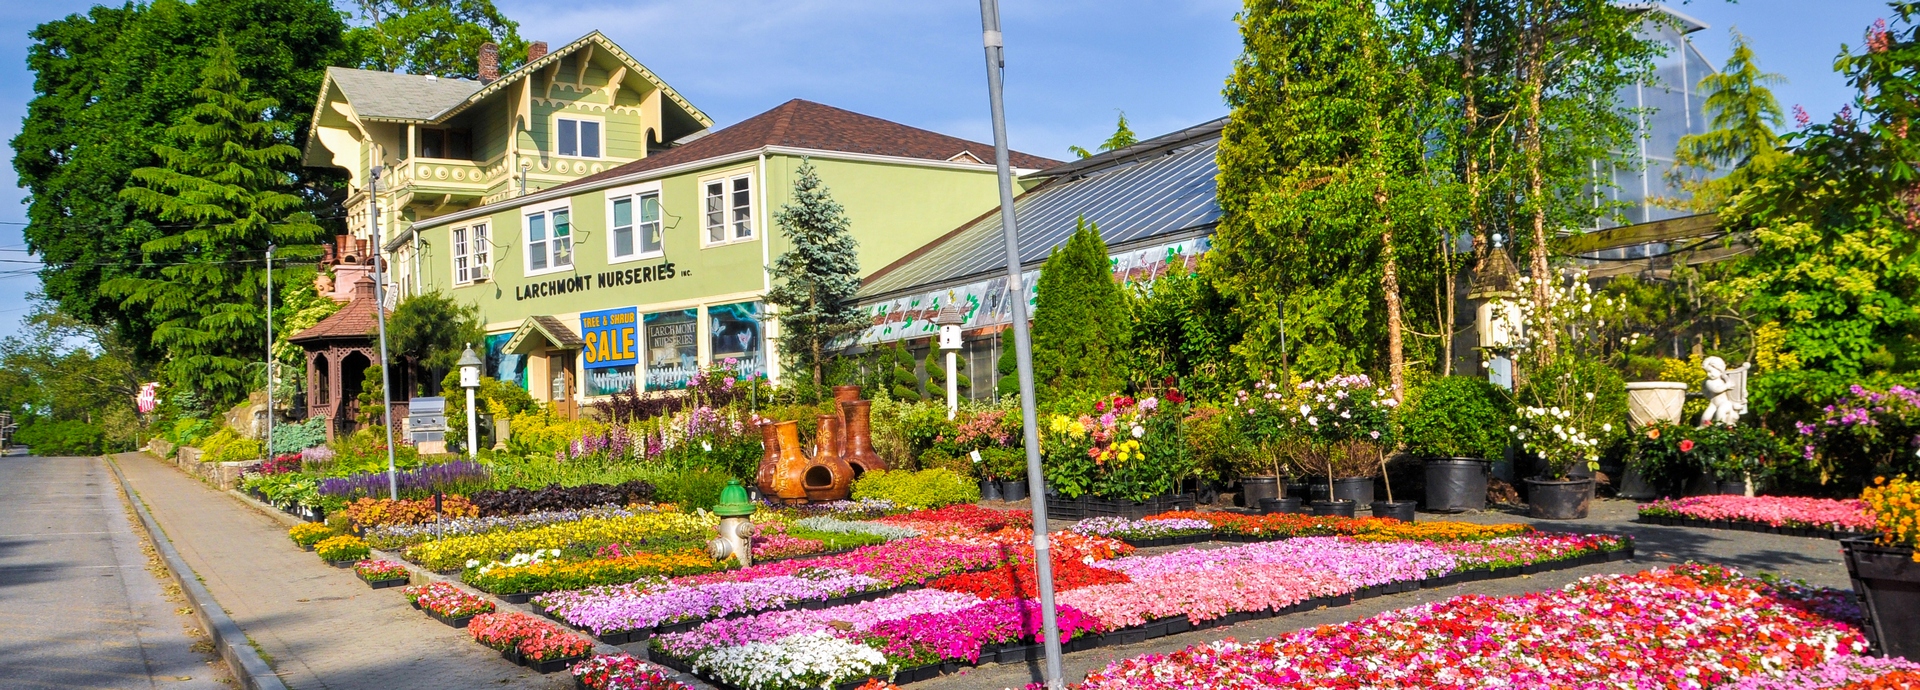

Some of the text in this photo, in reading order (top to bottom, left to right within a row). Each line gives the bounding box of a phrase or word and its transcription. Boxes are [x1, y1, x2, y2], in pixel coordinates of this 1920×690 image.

[516, 275, 592, 301] LARCHMONT
[598, 263, 676, 288] NURSERIES
[583, 312, 635, 328] TREE & SHRUB
[650, 322, 696, 337] LARCHMONT
[585, 327, 636, 363] SALE
